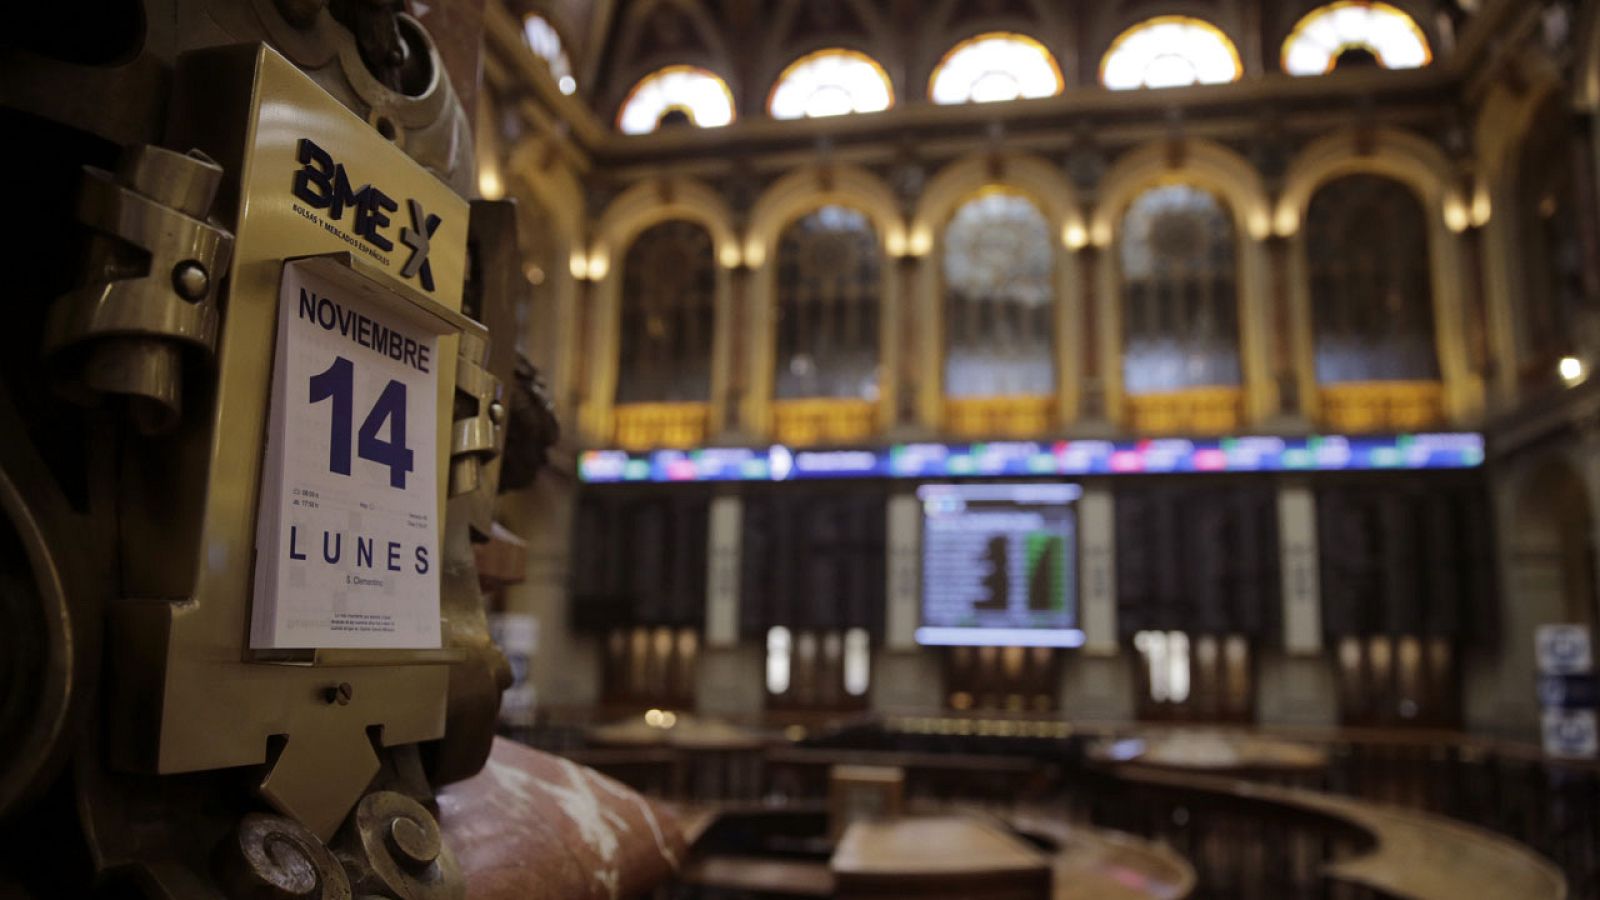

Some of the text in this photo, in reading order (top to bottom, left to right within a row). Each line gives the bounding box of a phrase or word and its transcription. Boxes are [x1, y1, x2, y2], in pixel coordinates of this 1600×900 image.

[292, 203, 318, 224] BOLSAS
[324, 223, 358, 247] MERCADOS
[299, 287, 430, 374] NOVIEMBRE
[309, 355, 414, 490] 14
[289, 525, 429, 575] LUNES
